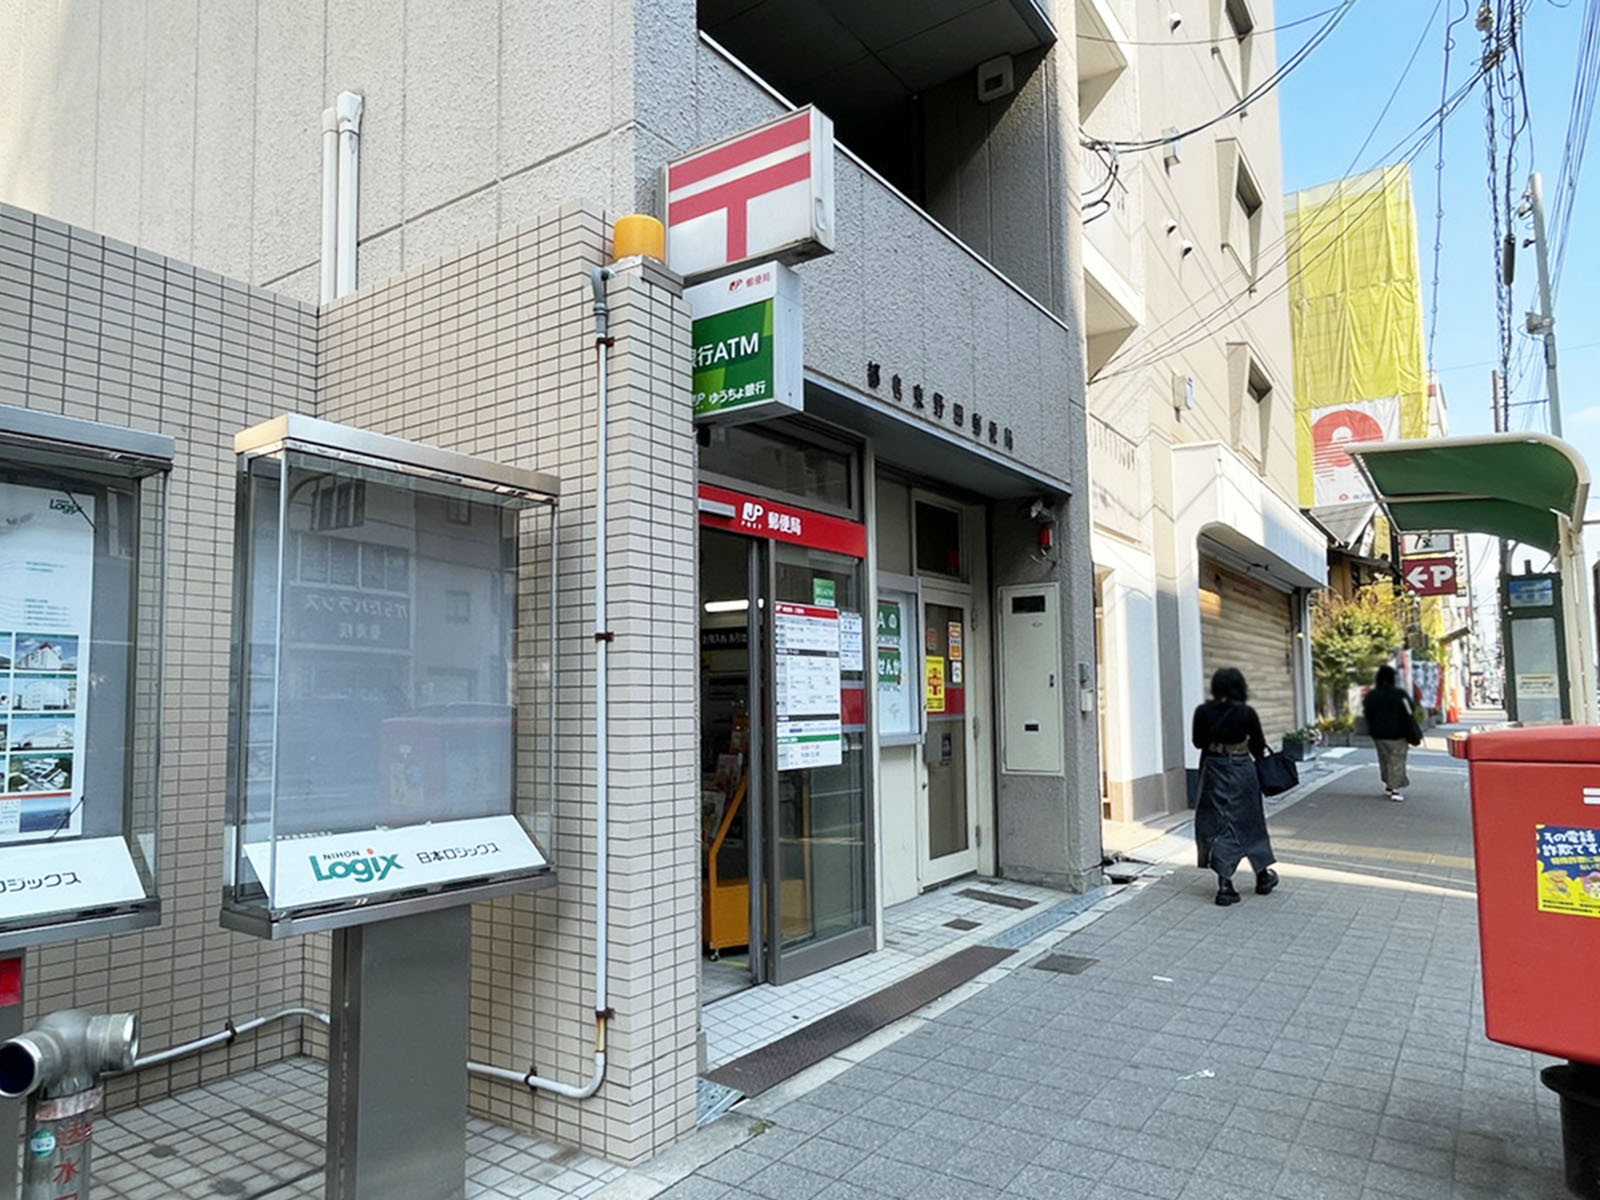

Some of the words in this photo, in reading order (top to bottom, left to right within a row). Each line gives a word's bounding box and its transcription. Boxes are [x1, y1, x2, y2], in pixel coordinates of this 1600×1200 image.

[709, 380, 766, 405] ゆうちょ銀行
[768, 512, 801, 535] 郵便局
[1430, 565, 1453, 588] P
[1544, 830, 1595, 844] その電話
[309, 848, 404, 883] Logix
[416, 842, 500, 864] 日本ロジックス
[323, 850, 360, 860] NIHON
